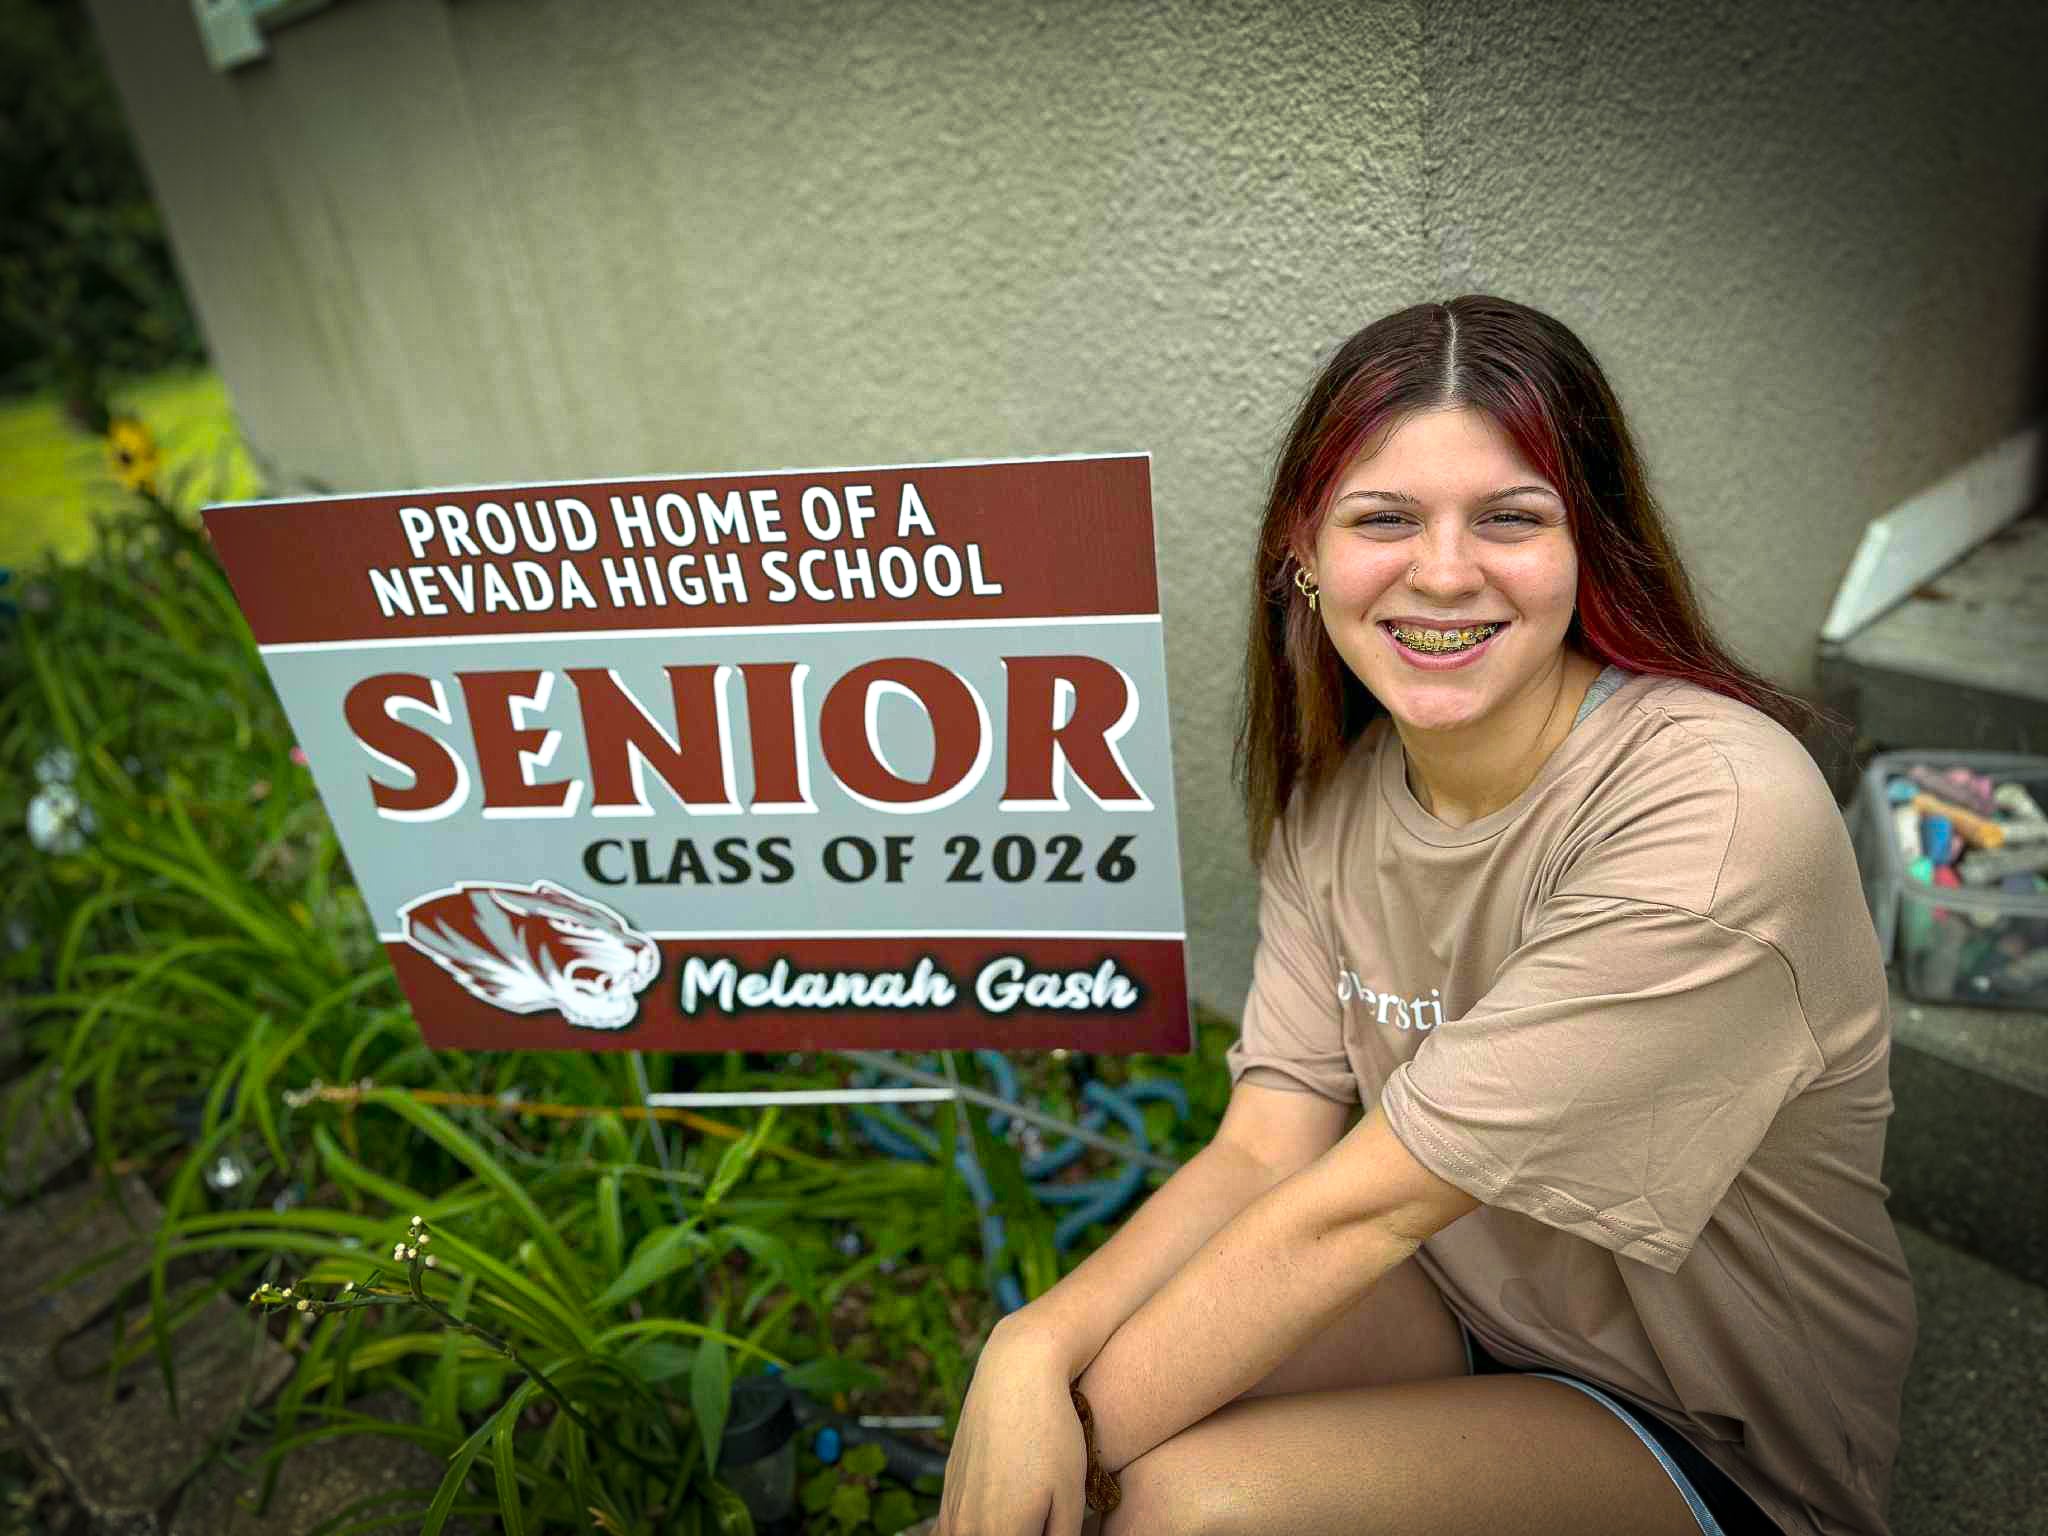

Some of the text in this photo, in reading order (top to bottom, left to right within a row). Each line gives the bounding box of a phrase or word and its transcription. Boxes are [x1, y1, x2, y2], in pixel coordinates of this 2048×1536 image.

[399, 483, 936, 559] PROUD HOME OF A
[368, 543, 1003, 617] NEVADA HIGH SCHOOL
[343, 655, 1155, 822] SENIOR
[582, 835, 1138, 885] CLASS OF 2026
[680, 957, 1138, 1015] Melanah Gash
